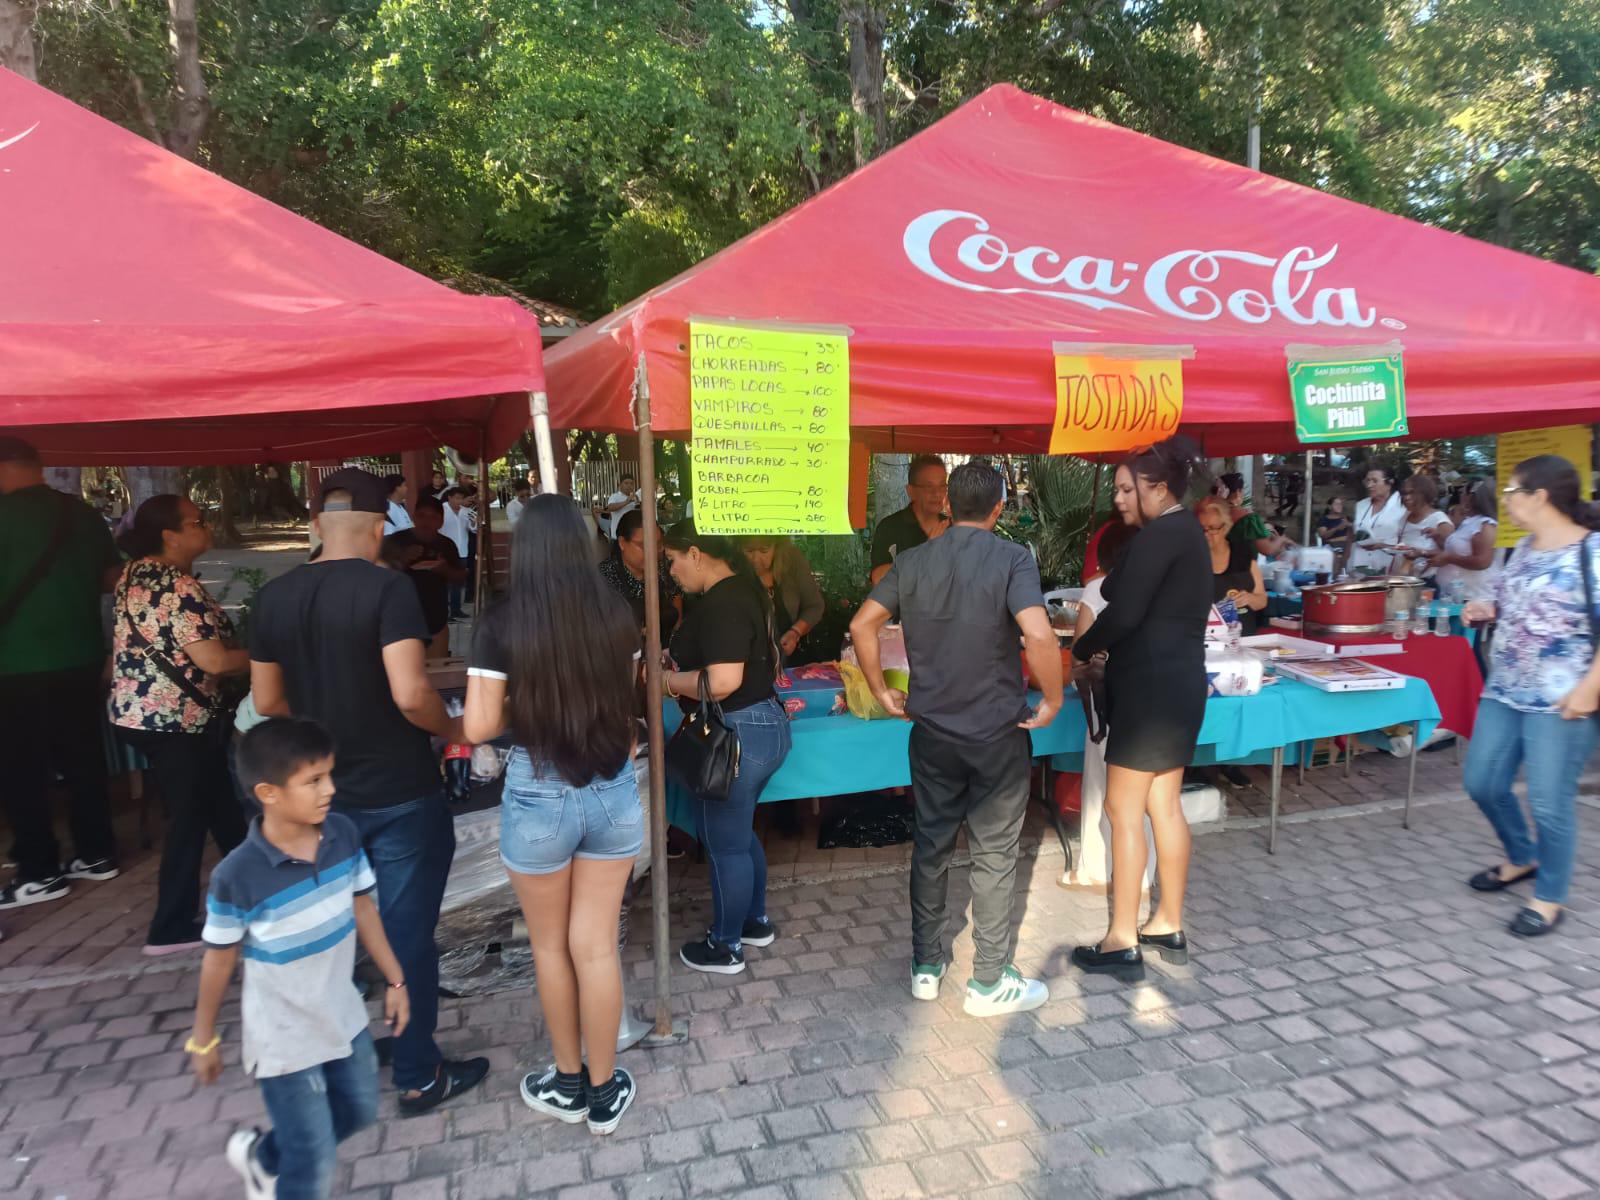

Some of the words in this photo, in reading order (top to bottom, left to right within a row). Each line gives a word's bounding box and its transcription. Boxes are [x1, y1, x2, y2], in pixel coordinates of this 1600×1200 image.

[903, 208, 1376, 329] Coca-Cola
[692, 333, 752, 350] TACOS
[692, 356, 787, 373] CHORREADAS
[816, 361, 834, 374] 80
[692, 375, 735, 390] PAPAS
[741, 379, 786, 394] LOCAS
[1058, 372, 1179, 432] TOSTADAS
[1304, 381, 1386, 406] Cochinita
[694, 399, 774, 416] VAMPIROS
[694, 415, 786, 432] QUESADILLAS
[809, 422, 826, 434] 80
[1327, 406, 1366, 430] Pibil
[694, 437, 761, 451] TAMALES
[806, 442, 824, 453] 40
[694, 453, 786, 467] CHAMPURRADO
[698, 471, 770, 484] BARBACOA
[698, 486, 739, 495] ORDEN
[807, 487, 823, 497] 80
[713, 499, 746, 510] LITRO
[804, 499, 823, 508] 140
[712, 513, 750, 522] LITRO
